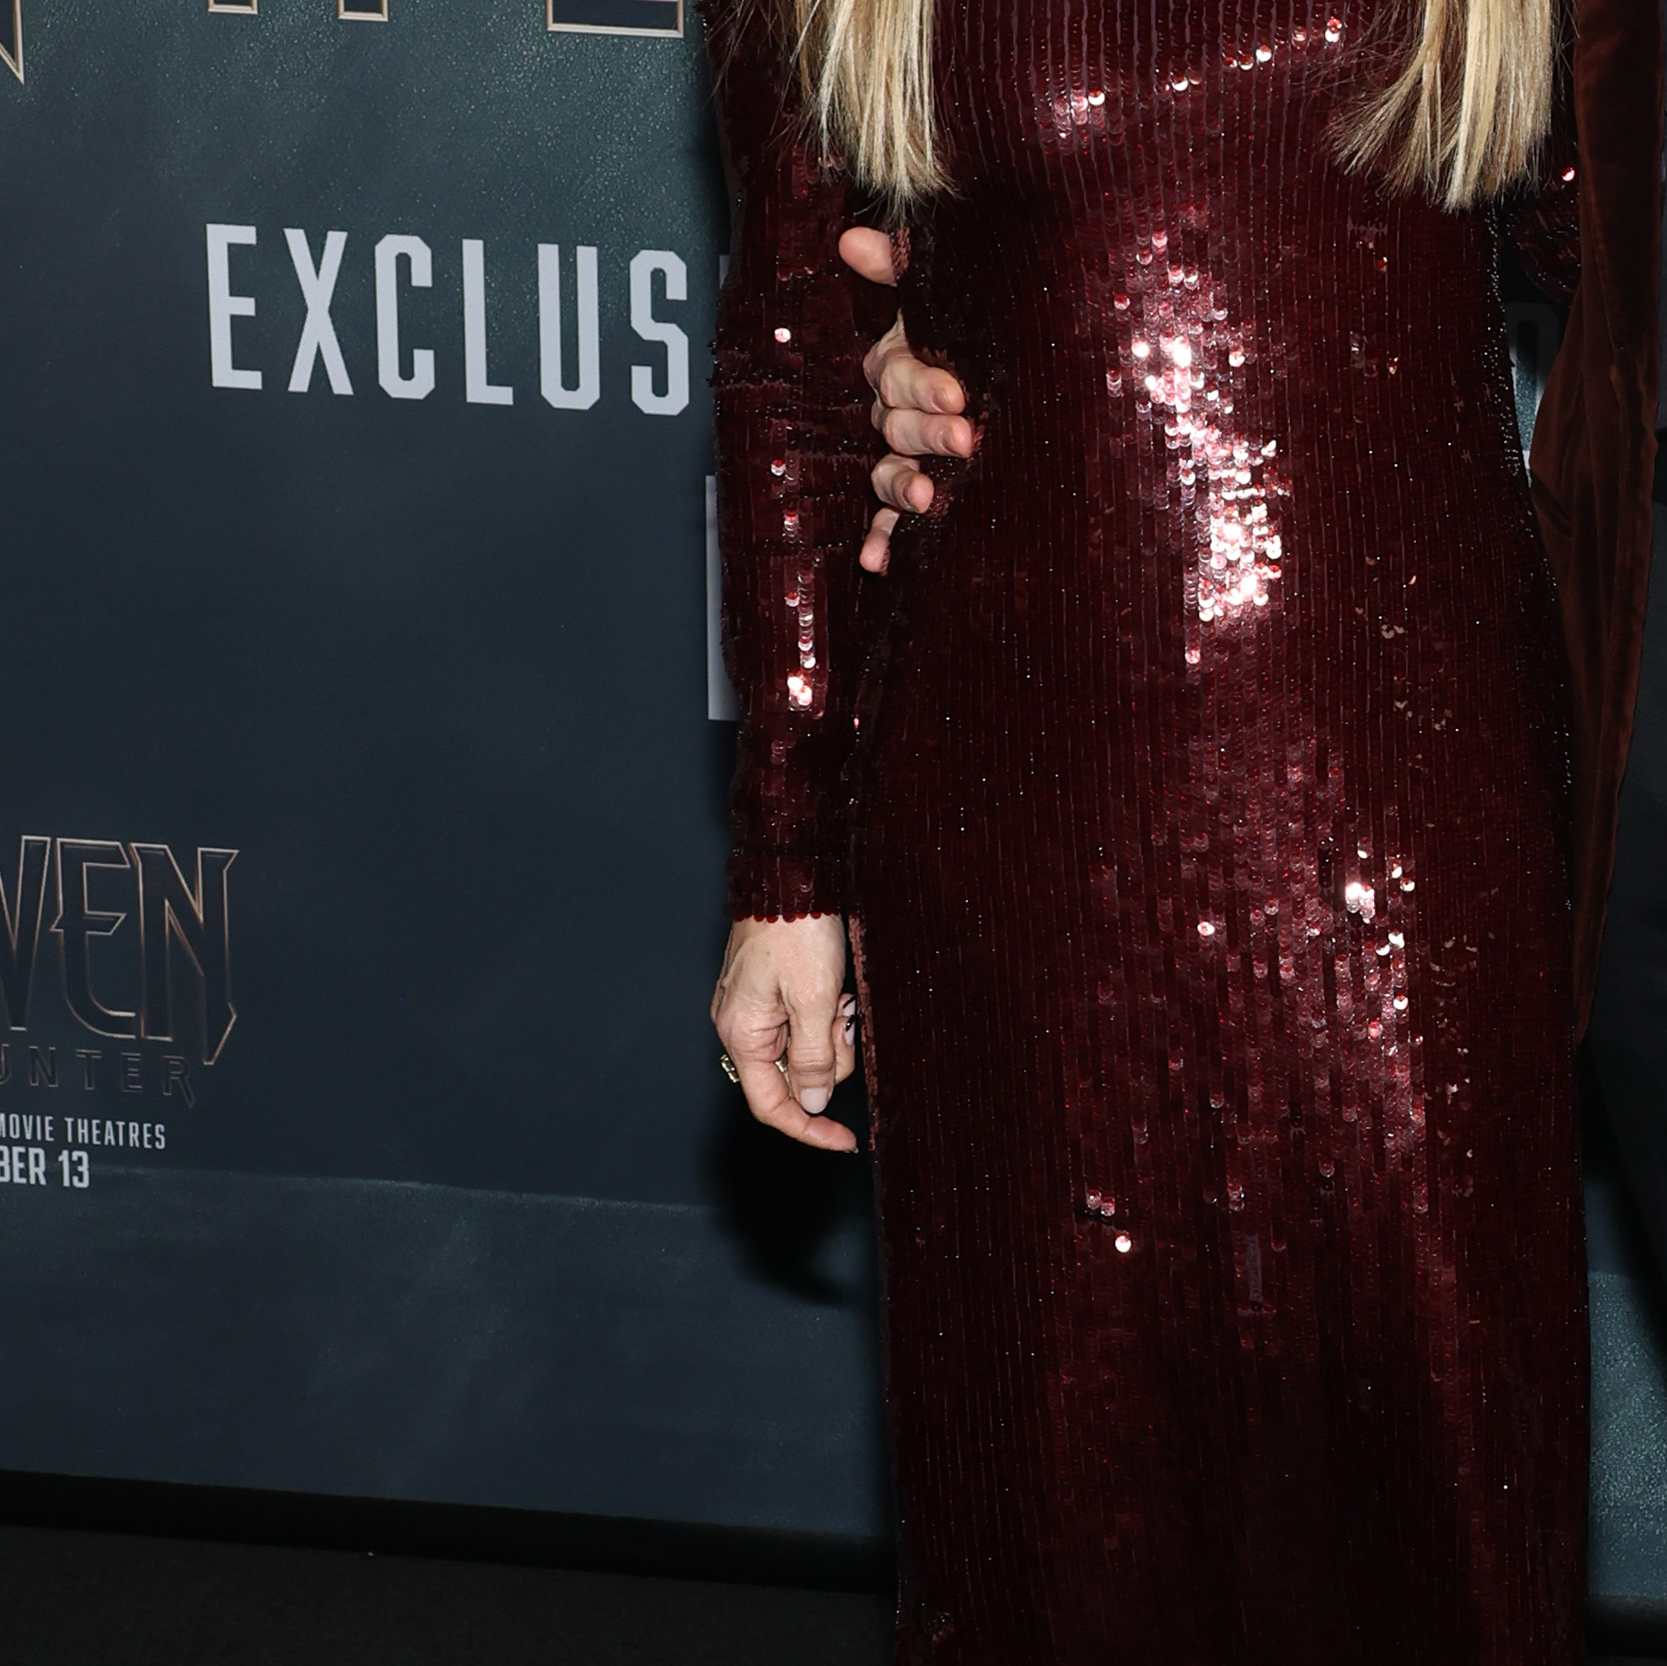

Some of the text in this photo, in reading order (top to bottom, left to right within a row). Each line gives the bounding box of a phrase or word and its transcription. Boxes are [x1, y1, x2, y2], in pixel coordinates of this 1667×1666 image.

[206, 223, 732, 417] EXCLUS
[64, 1117, 166, 1150] THEATRES
[58, 1149, 90, 1188] 13
